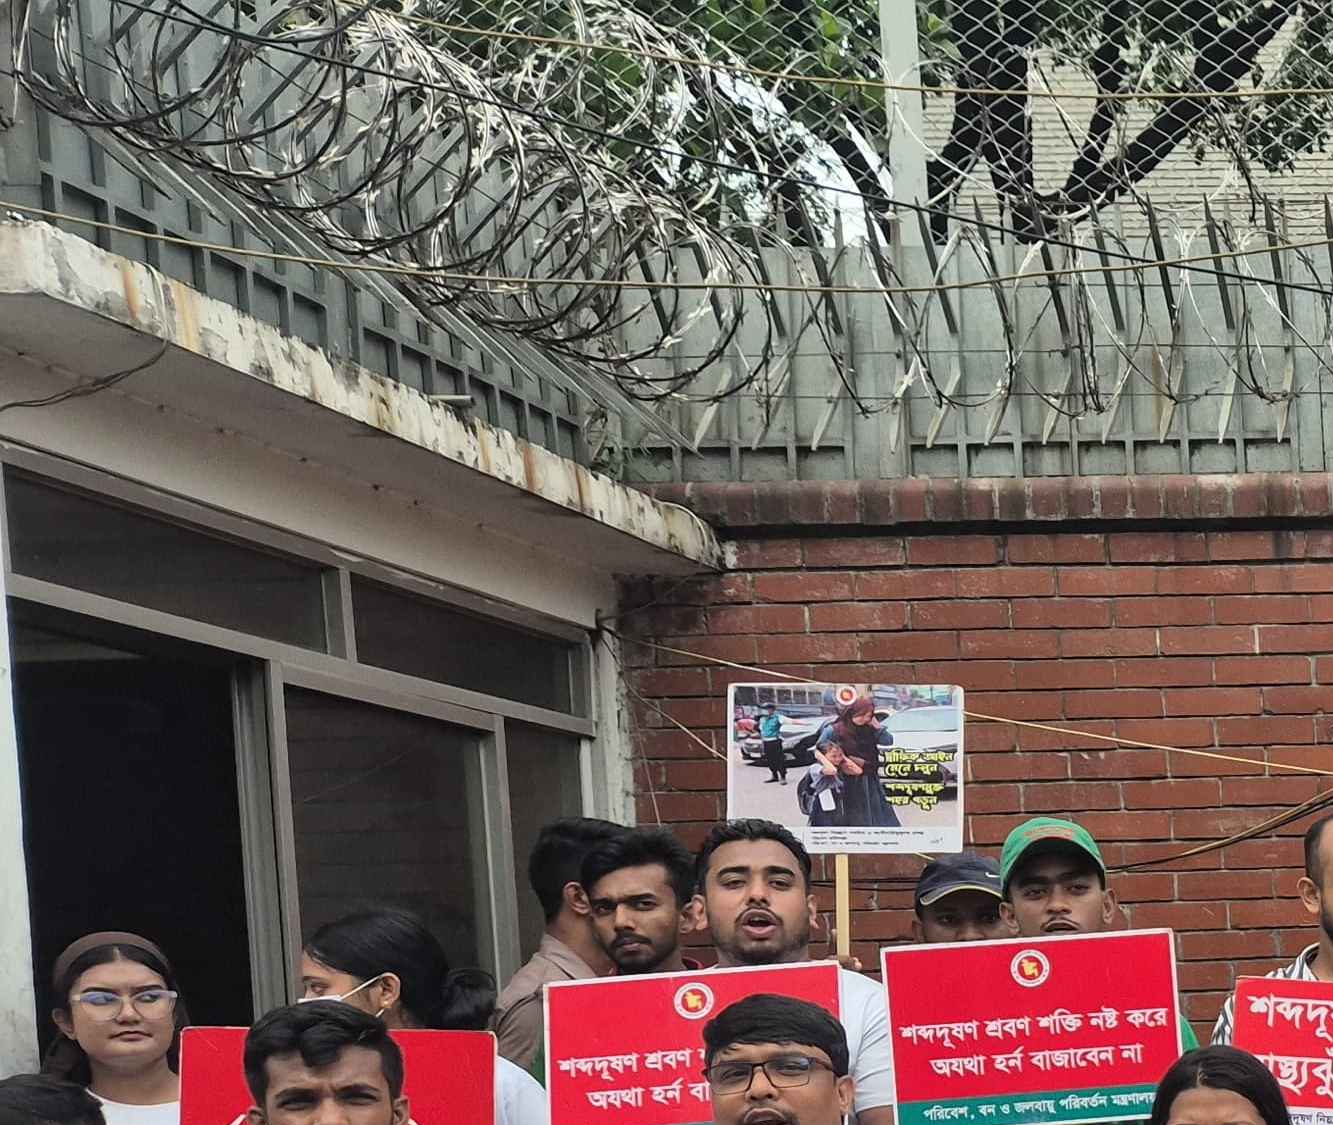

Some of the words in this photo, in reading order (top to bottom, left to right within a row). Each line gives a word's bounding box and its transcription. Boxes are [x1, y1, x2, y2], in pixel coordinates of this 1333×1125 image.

[900, 1020, 978, 1049] শব্দদূষণ
[985, 1017, 1031, 1040] শ্রবণ
[1037, 1009, 1084, 1034] শক্তি
[1089, 1006, 1119, 1031] নষ্ট
[1124, 1007, 1169, 1028] করে
[558, 1052, 637, 1081] শব্দদূষণ
[645, 1048, 692, 1070] শ্রবণ
[930, 1055, 986, 1078] অযথা
[992, 1047, 1025, 1073] হর্ন
[1029, 1046, 1115, 1072] বাজাবেন
[1120, 1043, 1145, 1065] না
[587, 1086, 643, 1110] অযথা
[651, 1078, 684, 1104] হর্ন
[979, 1104, 996, 1117] বন
[1000, 1103, 1010, 1115] ও
[1014, 1098, 1056, 1114] জলবায়ু
[1059, 1092, 1107, 1110] পরিবর্তন
